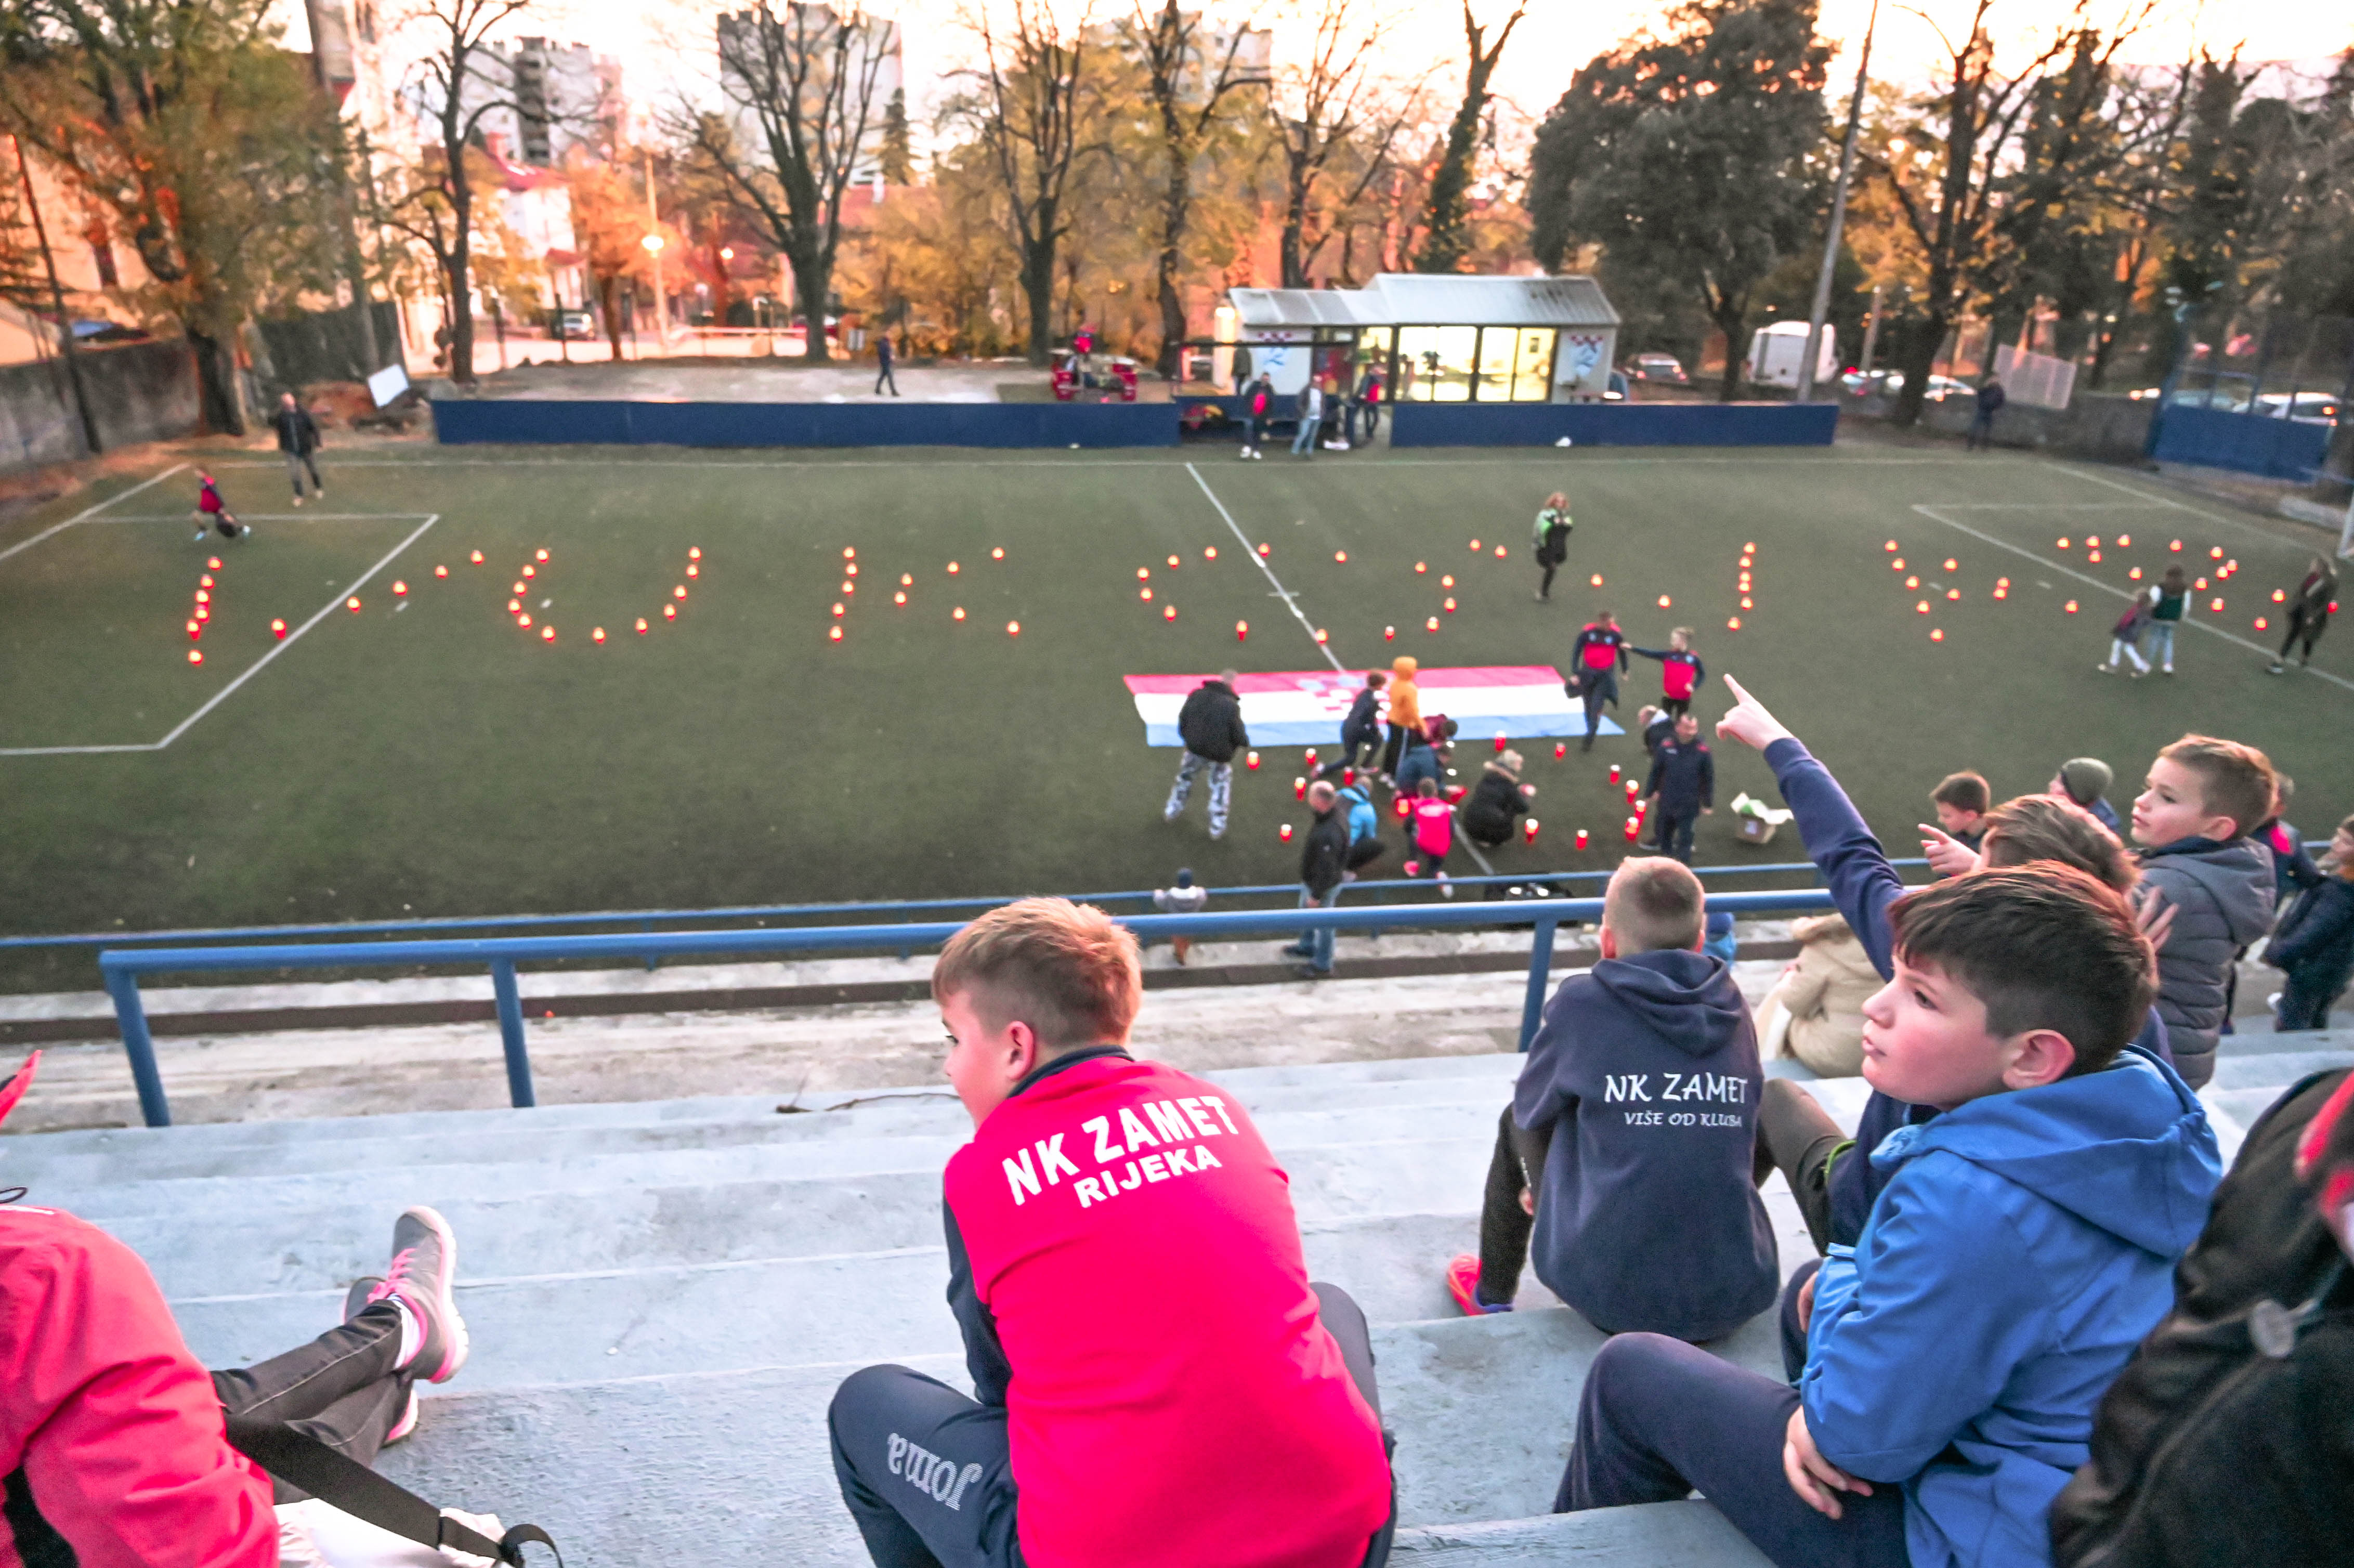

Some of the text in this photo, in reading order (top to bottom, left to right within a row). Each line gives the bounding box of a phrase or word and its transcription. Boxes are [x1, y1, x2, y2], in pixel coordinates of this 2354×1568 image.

[1604, 1072, 1749, 1104] NK ZAMET
[1624, 1109, 1664, 1126] VIŠE
[1668, 1112, 1696, 1127] OD
[1002, 1095, 1239, 1206] NK ZAMET
[1073, 1144, 1223, 1208] RIJEKA
